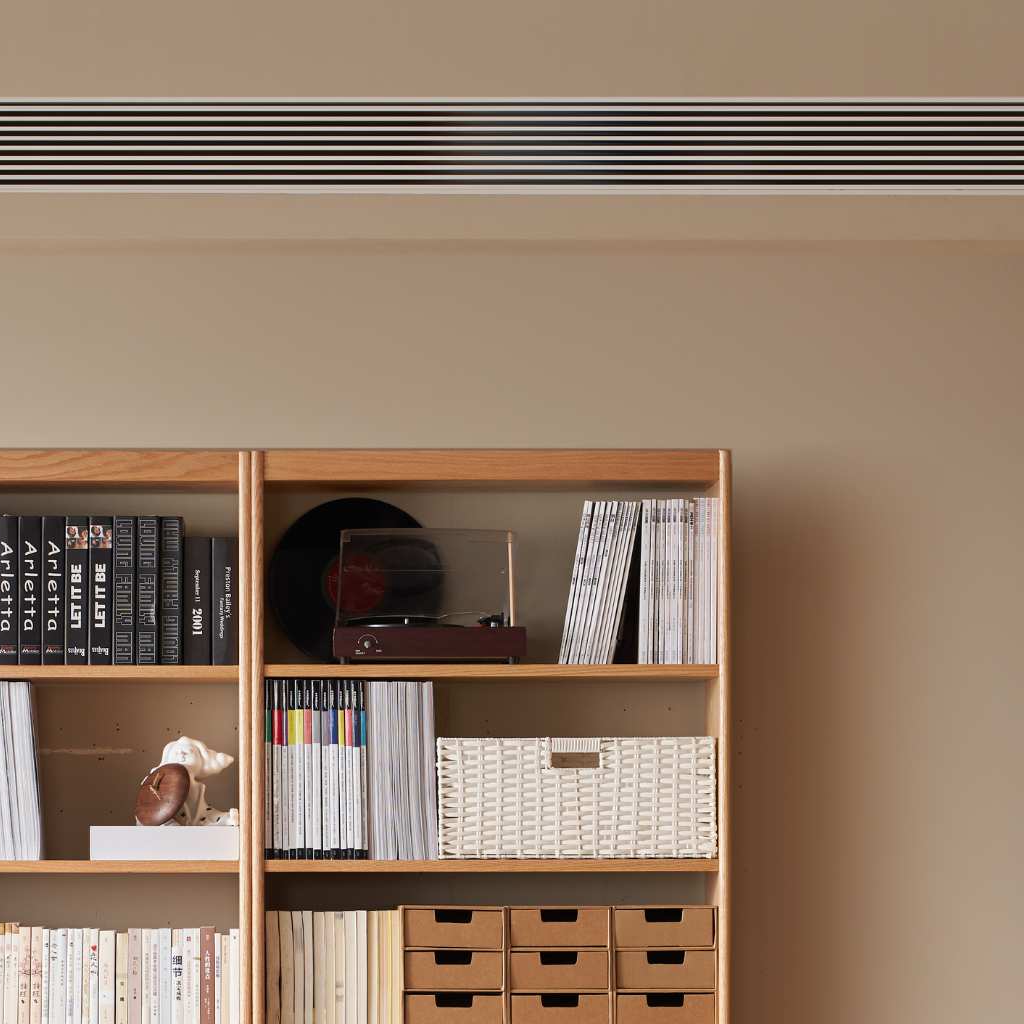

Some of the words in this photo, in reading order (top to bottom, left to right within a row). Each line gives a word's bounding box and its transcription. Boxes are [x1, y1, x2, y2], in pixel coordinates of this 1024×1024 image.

[71, 564, 82, 583] BE
[95, 564, 106, 582] BE
[0, 541, 14, 631] Arletta
[24, 541, 38, 631] Arletta
[48, 541, 62, 631] Arletta
[71, 586, 82, 600] IT
[95, 585, 106, 598] IT
[71, 602, 82, 628] LET
[95, 602, 106, 628] LET
[224, 594, 232, 618] Bailey's
[192, 608, 202, 636] 2001
[172, 955, 182, 978] 细节
